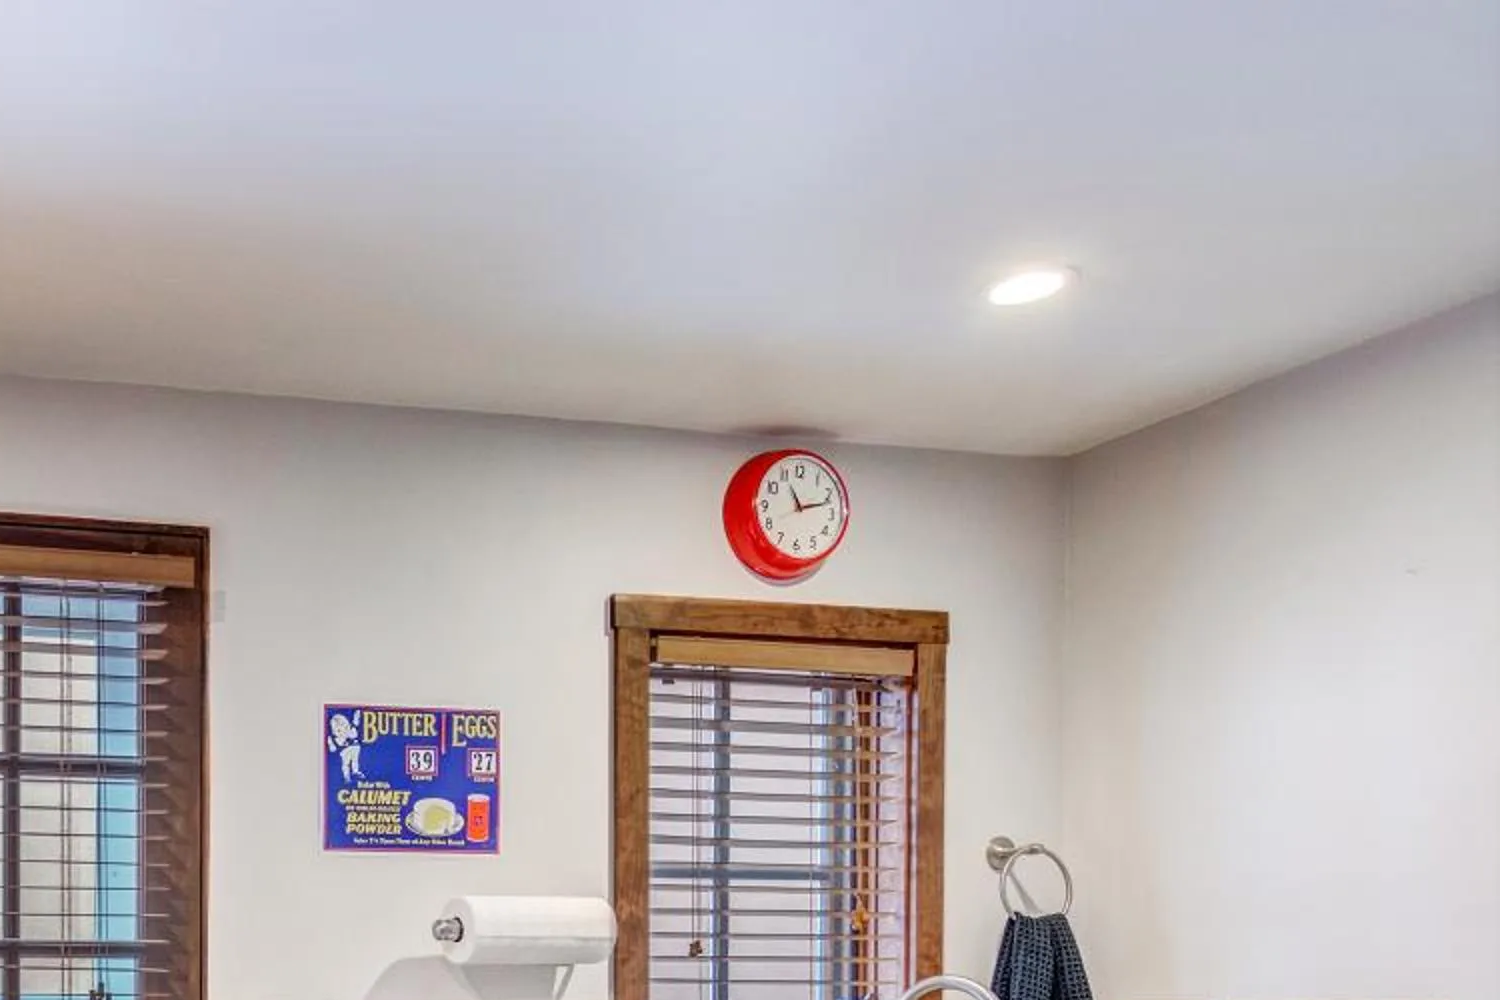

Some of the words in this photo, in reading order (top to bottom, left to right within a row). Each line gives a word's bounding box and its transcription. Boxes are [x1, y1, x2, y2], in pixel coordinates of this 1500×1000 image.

[767, 481, 779, 495] 10
[761, 499, 769, 512] 9
[765, 517, 773, 530] 8
[820, 525, 829, 536] 4
[792, 538, 800, 551] 6
[362, 711, 437, 743] BUTTER
[451, 714, 497, 747] EGGS
[411, 751, 433, 770] 39
[473, 753, 493, 771] 27
[337, 789, 412, 806] CALUMET
